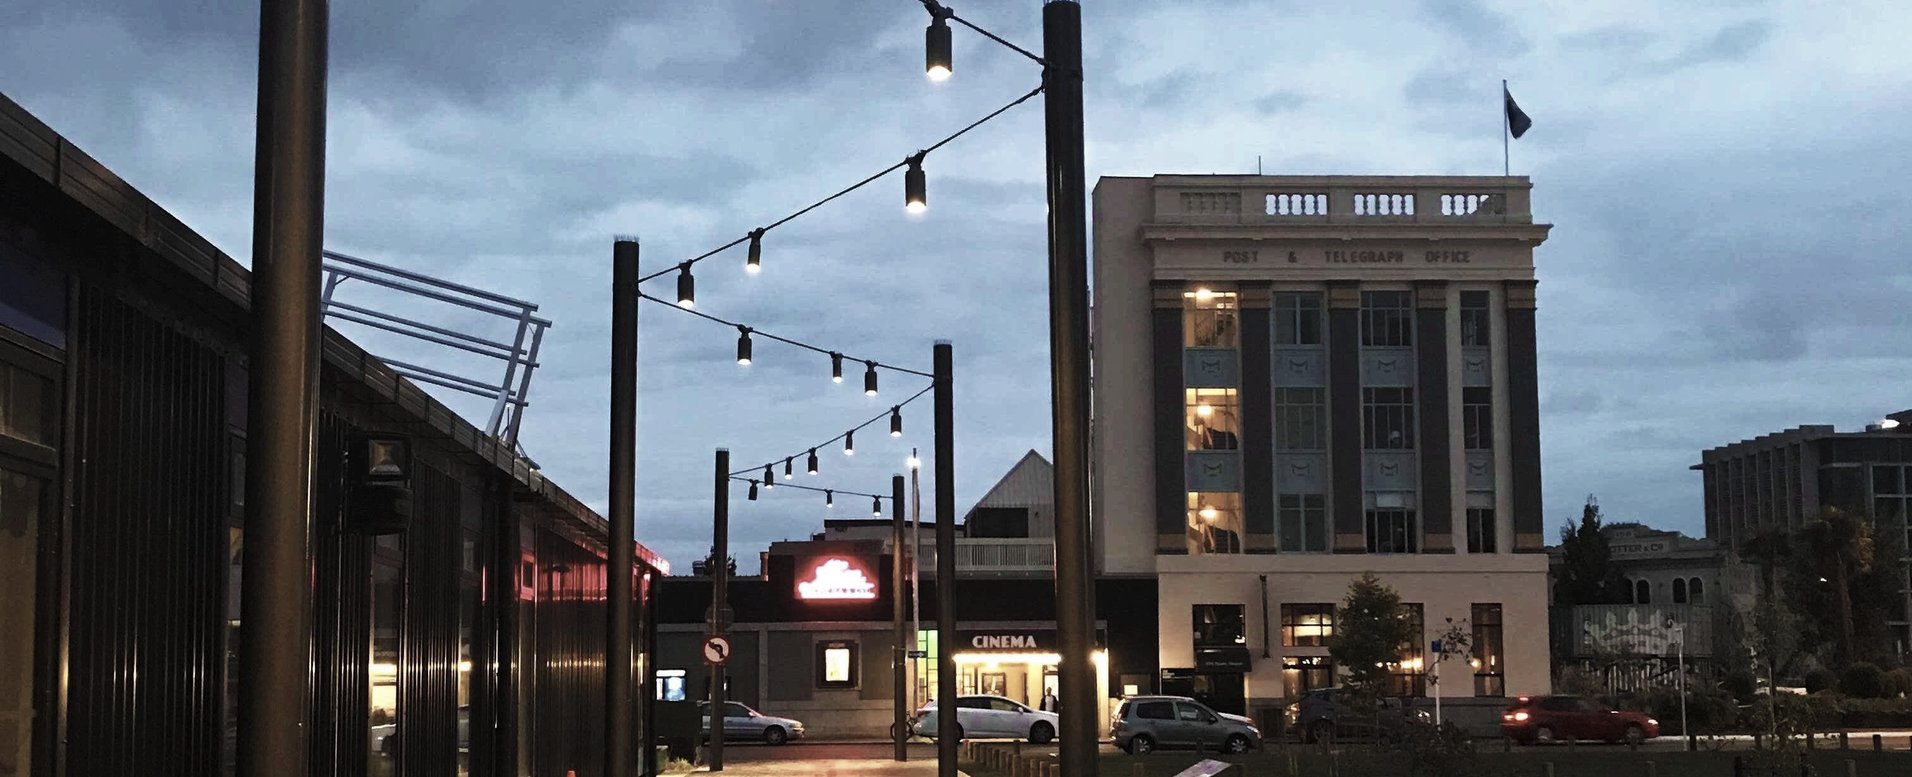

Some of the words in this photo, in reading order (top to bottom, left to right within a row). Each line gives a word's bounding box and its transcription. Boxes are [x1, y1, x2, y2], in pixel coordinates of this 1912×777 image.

[1223, 251, 1259, 263] POST
[1287, 251, 1298, 263] &
[1324, 251, 1404, 263] TELEGRAPH
[1424, 251, 1471, 263] OFFICE
[1608, 544, 1642, 553] OTTER
[971, 635, 1037, 648] CINEMA
